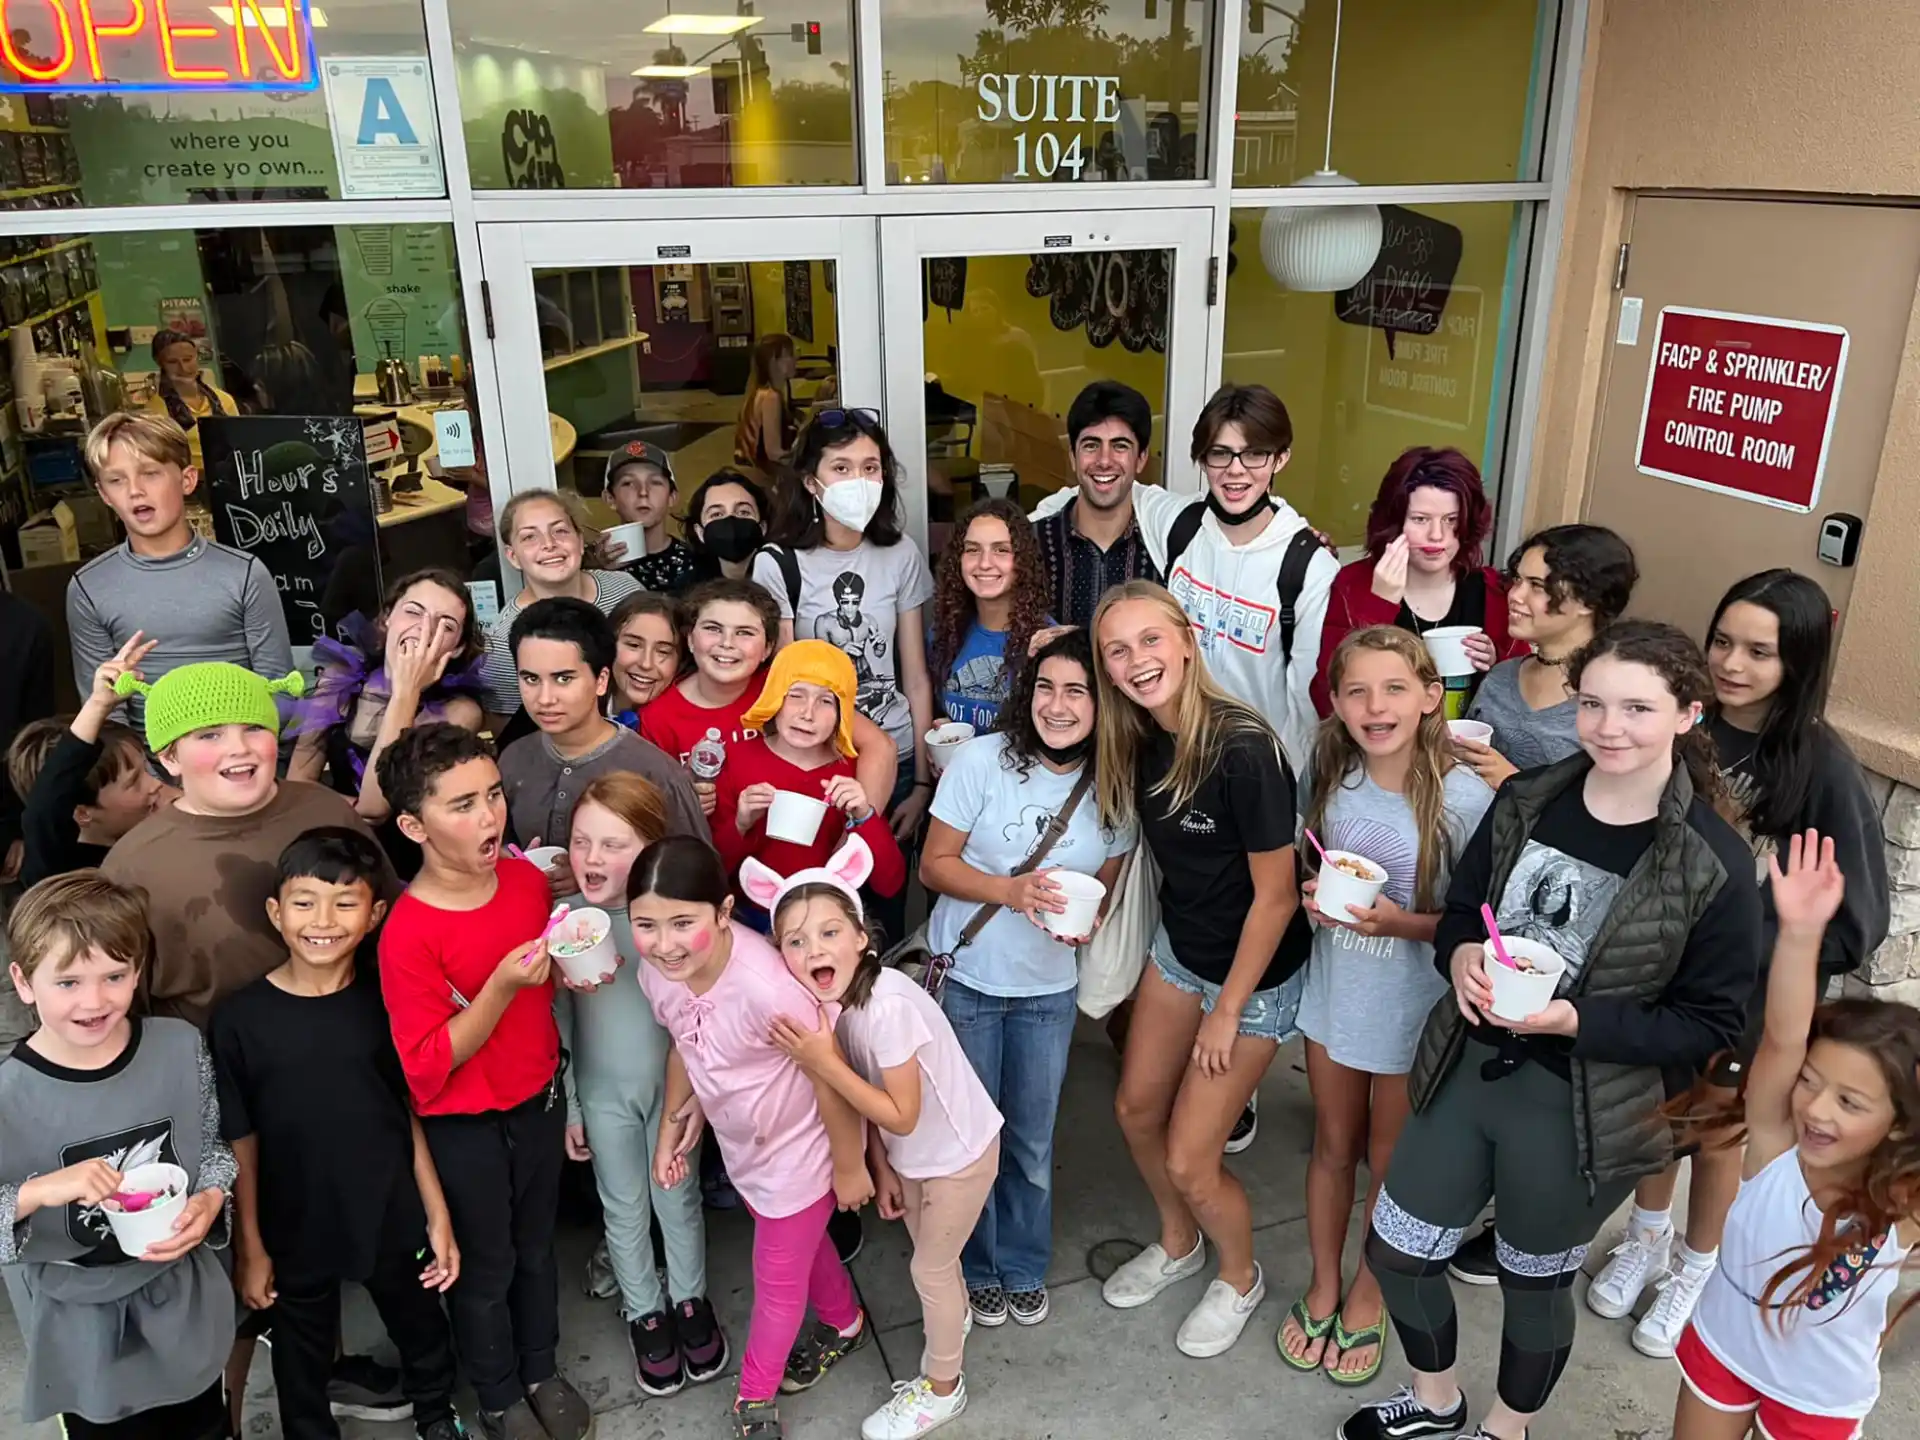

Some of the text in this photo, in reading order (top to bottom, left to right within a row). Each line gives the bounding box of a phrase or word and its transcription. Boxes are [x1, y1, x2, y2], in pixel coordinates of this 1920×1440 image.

[0, 0, 302, 82] OPEN
[356, 78, 419, 145] A
[977, 73, 1121, 122] SUITE
[170, 132, 289, 151] where you
[1013, 132, 1085, 180] 104
[144, 160, 216, 177] create
[223, 161, 250, 179] yo
[161, 298, 200, 308] PITAYA
[385, 283, 421, 293] shake
[1660, 342, 1832, 391] FACP & SPRINKLER/
[1687, 385, 1783, 425] FIRE PUMP
[1664, 420, 1796, 470] CONTROL ROOM
[233, 449, 339, 500] Hours
[225, 501, 326, 559] Daily
